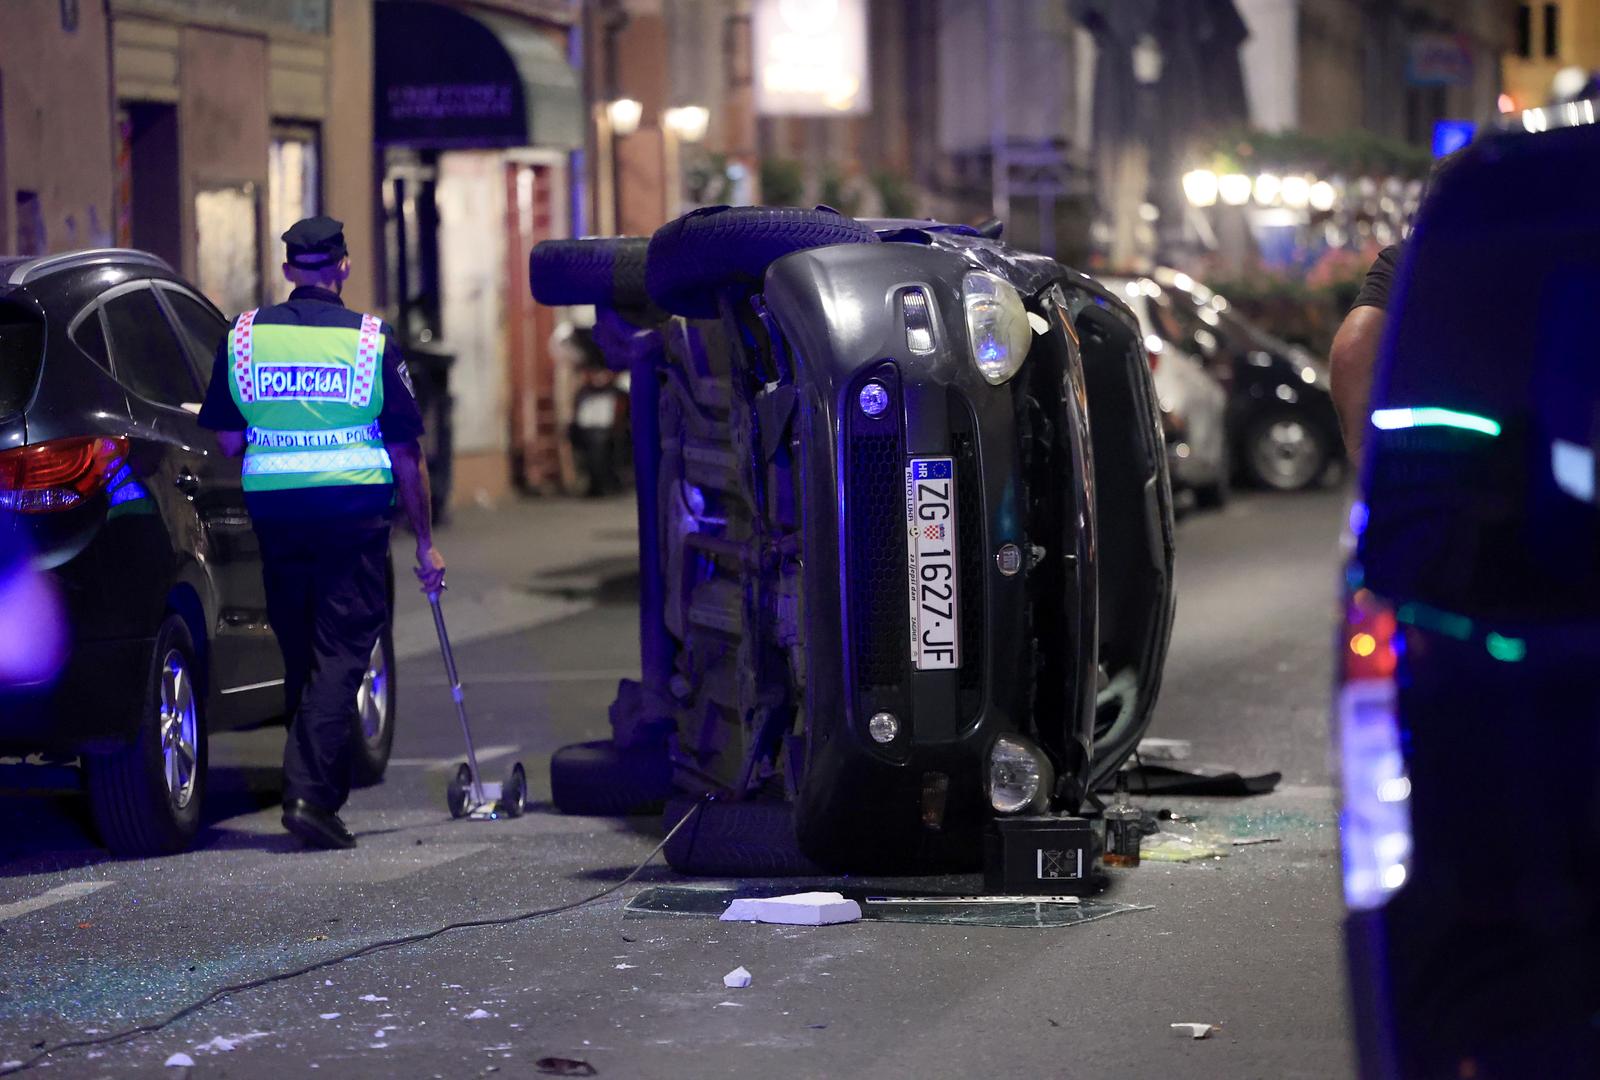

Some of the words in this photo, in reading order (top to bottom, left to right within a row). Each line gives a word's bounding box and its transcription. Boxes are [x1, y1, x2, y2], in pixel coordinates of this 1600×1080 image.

[260, 370, 344, 394] POLICIJA
[918, 463, 928, 478] HR
[906, 471, 914, 496] AUTO
[917, 483, 950, 521] ZG
